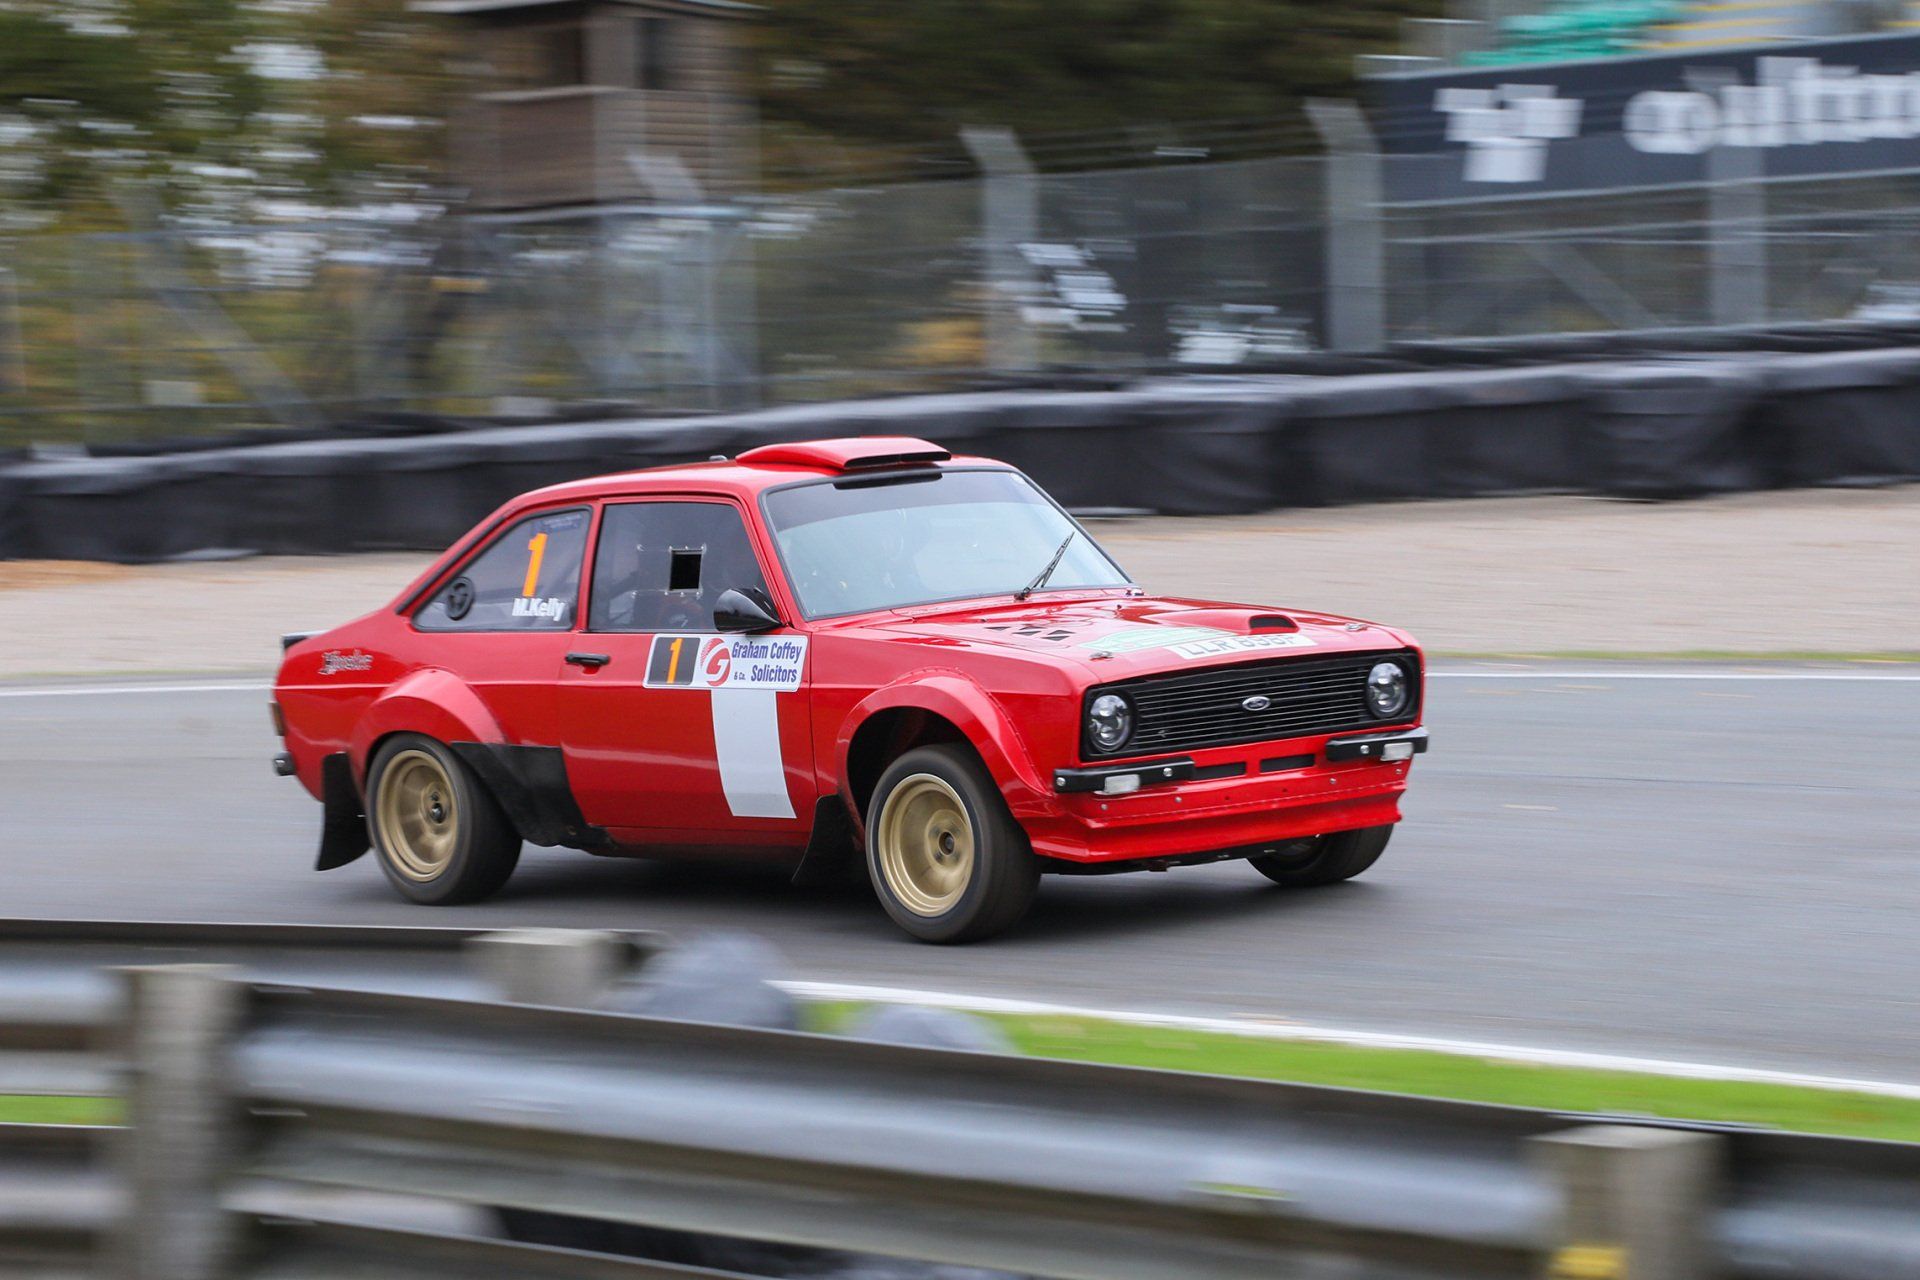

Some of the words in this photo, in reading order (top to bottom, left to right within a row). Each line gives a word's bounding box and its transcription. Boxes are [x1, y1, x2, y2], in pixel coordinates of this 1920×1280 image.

[522, 532, 548, 597] 1
[512, 597, 565, 622] M.Kelly
[732, 641, 768, 659] Graham
[770, 641, 802, 664] Coffey
[1177, 640, 1236, 655] LLR
[666, 637, 683, 684] 1
[750, 664, 797, 683] Solicitors
